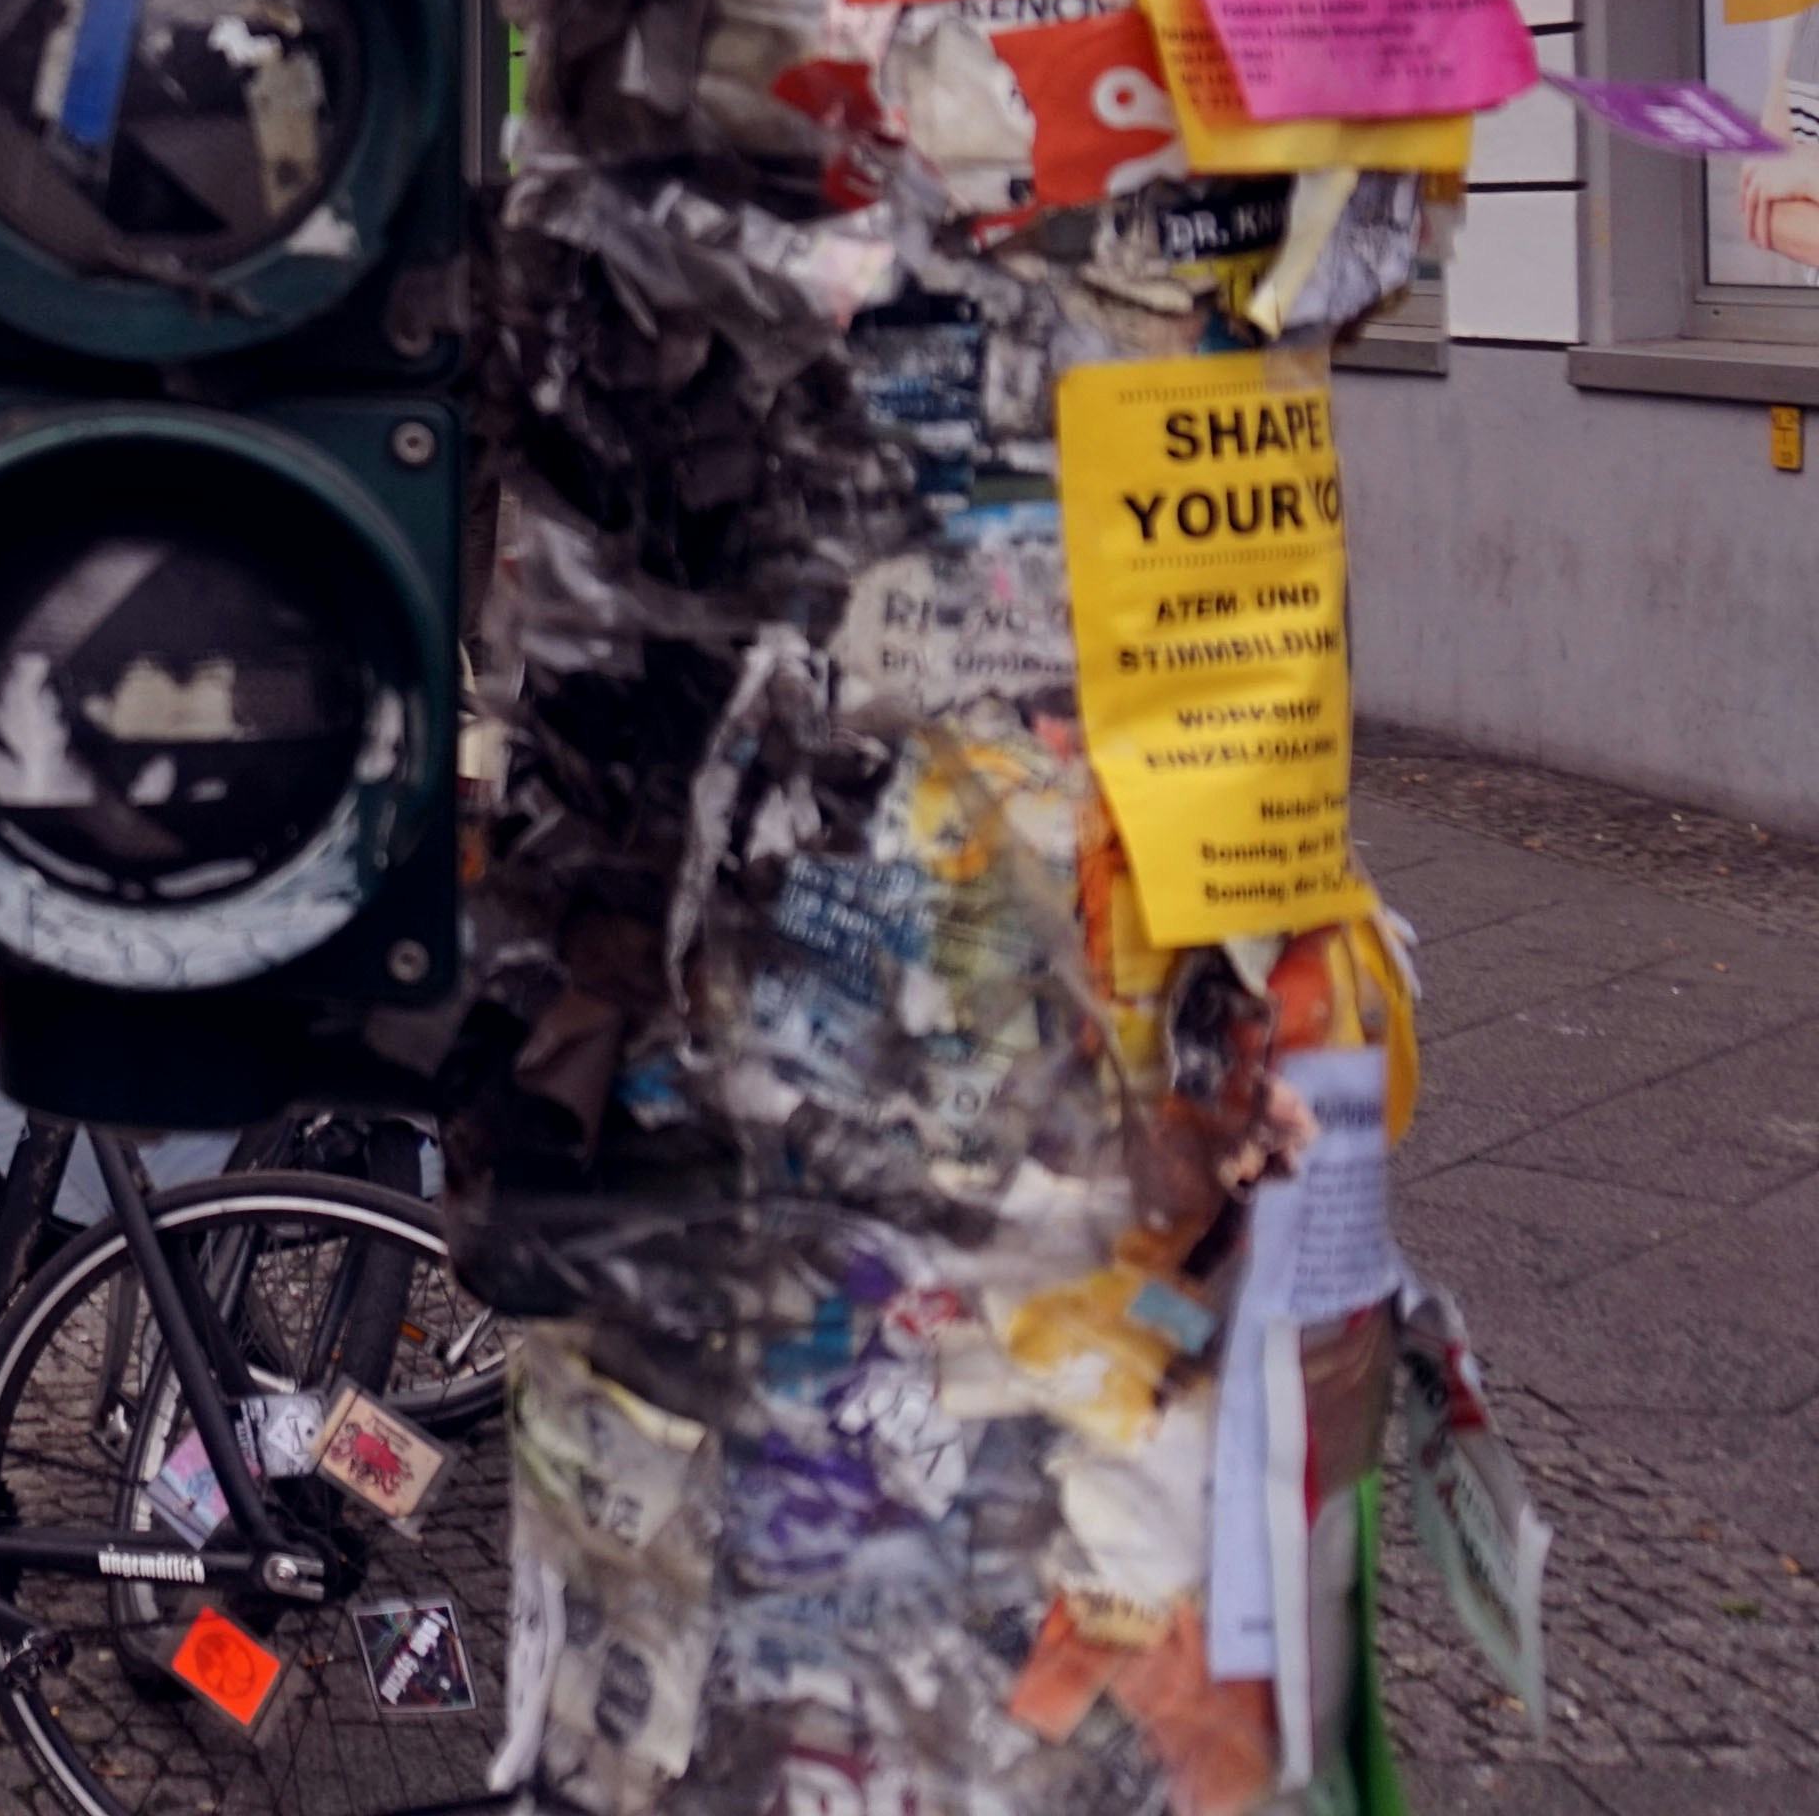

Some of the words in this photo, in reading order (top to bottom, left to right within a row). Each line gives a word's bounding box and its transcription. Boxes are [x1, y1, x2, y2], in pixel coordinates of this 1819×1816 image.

[1165, 400, 1323, 461] SHAPE
[1123, 482, 1304, 542] YOUR
[1257, 583, 1319, 611] UND
